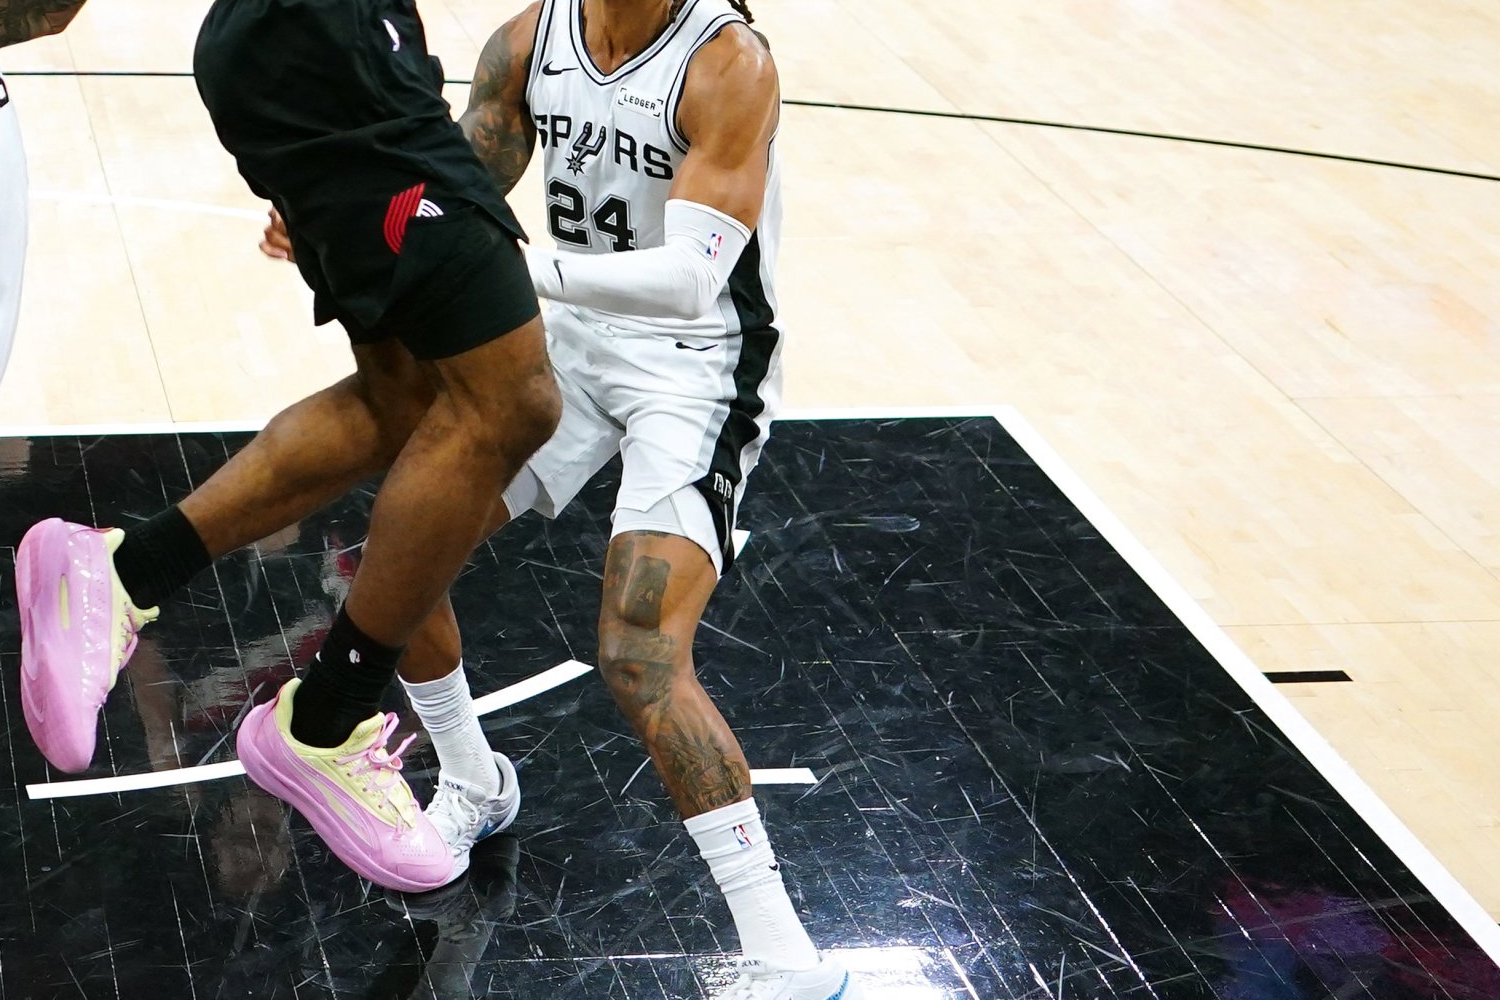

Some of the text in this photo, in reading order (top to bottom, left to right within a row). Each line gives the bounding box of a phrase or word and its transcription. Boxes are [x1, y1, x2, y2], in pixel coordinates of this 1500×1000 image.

[623, 93, 657, 111] LEDGER
[534, 113, 674, 181] SPURS
[547, 177, 637, 252] 24
